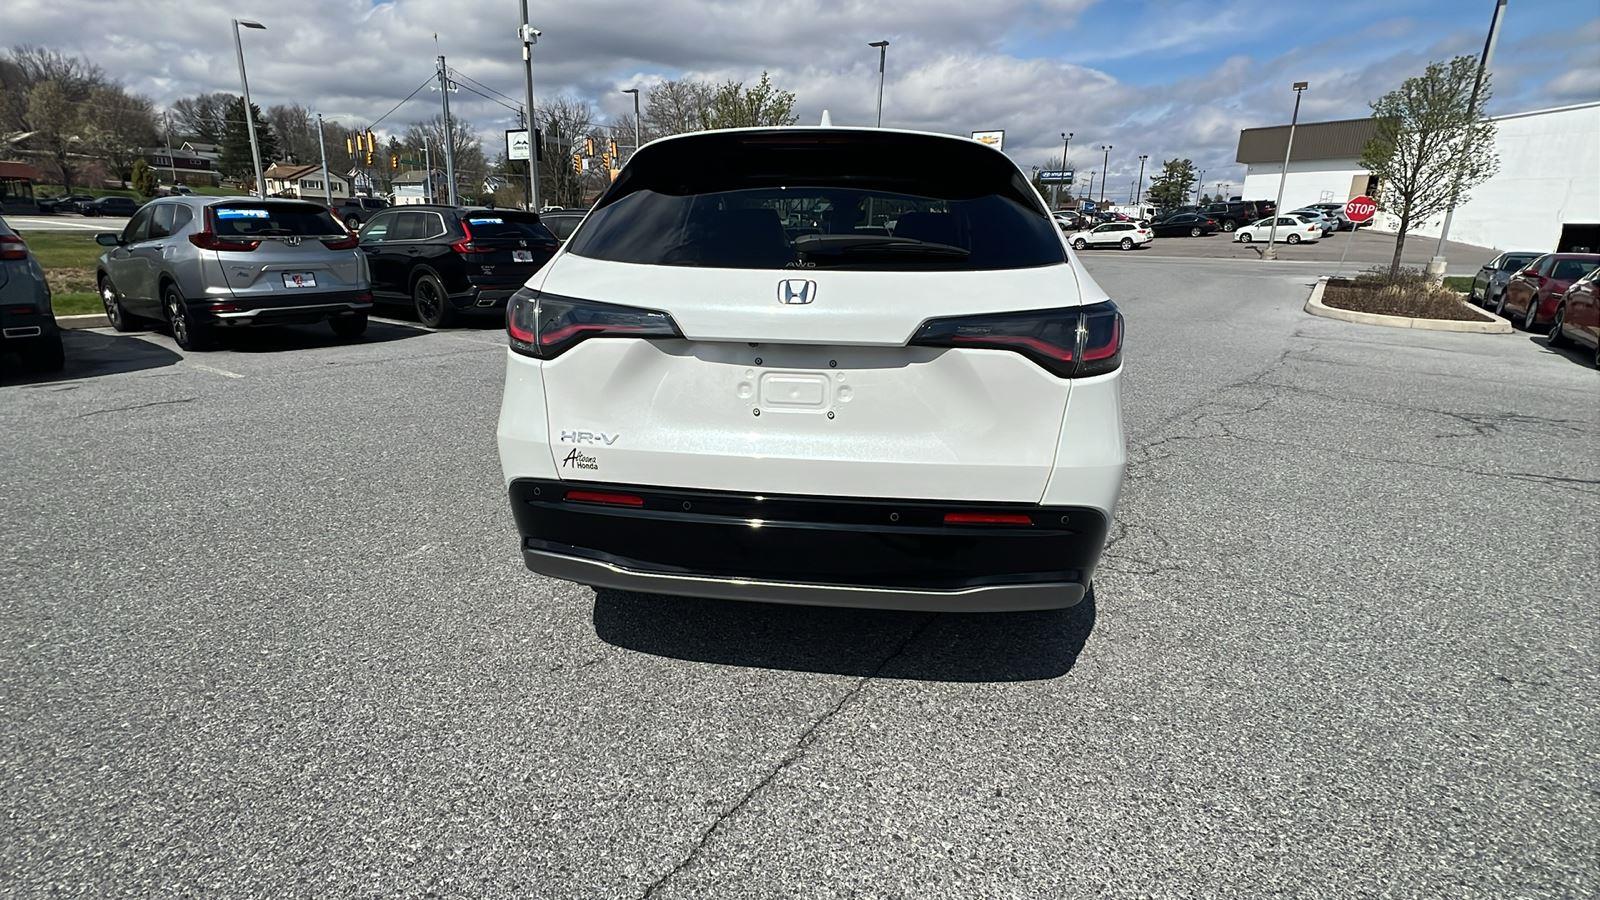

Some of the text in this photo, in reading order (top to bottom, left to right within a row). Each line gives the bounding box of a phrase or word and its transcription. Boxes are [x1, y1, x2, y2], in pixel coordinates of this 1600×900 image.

[1347, 203, 1375, 215] STOP
[561, 430, 620, 446] HR-V
[577, 462, 599, 470] Honda
